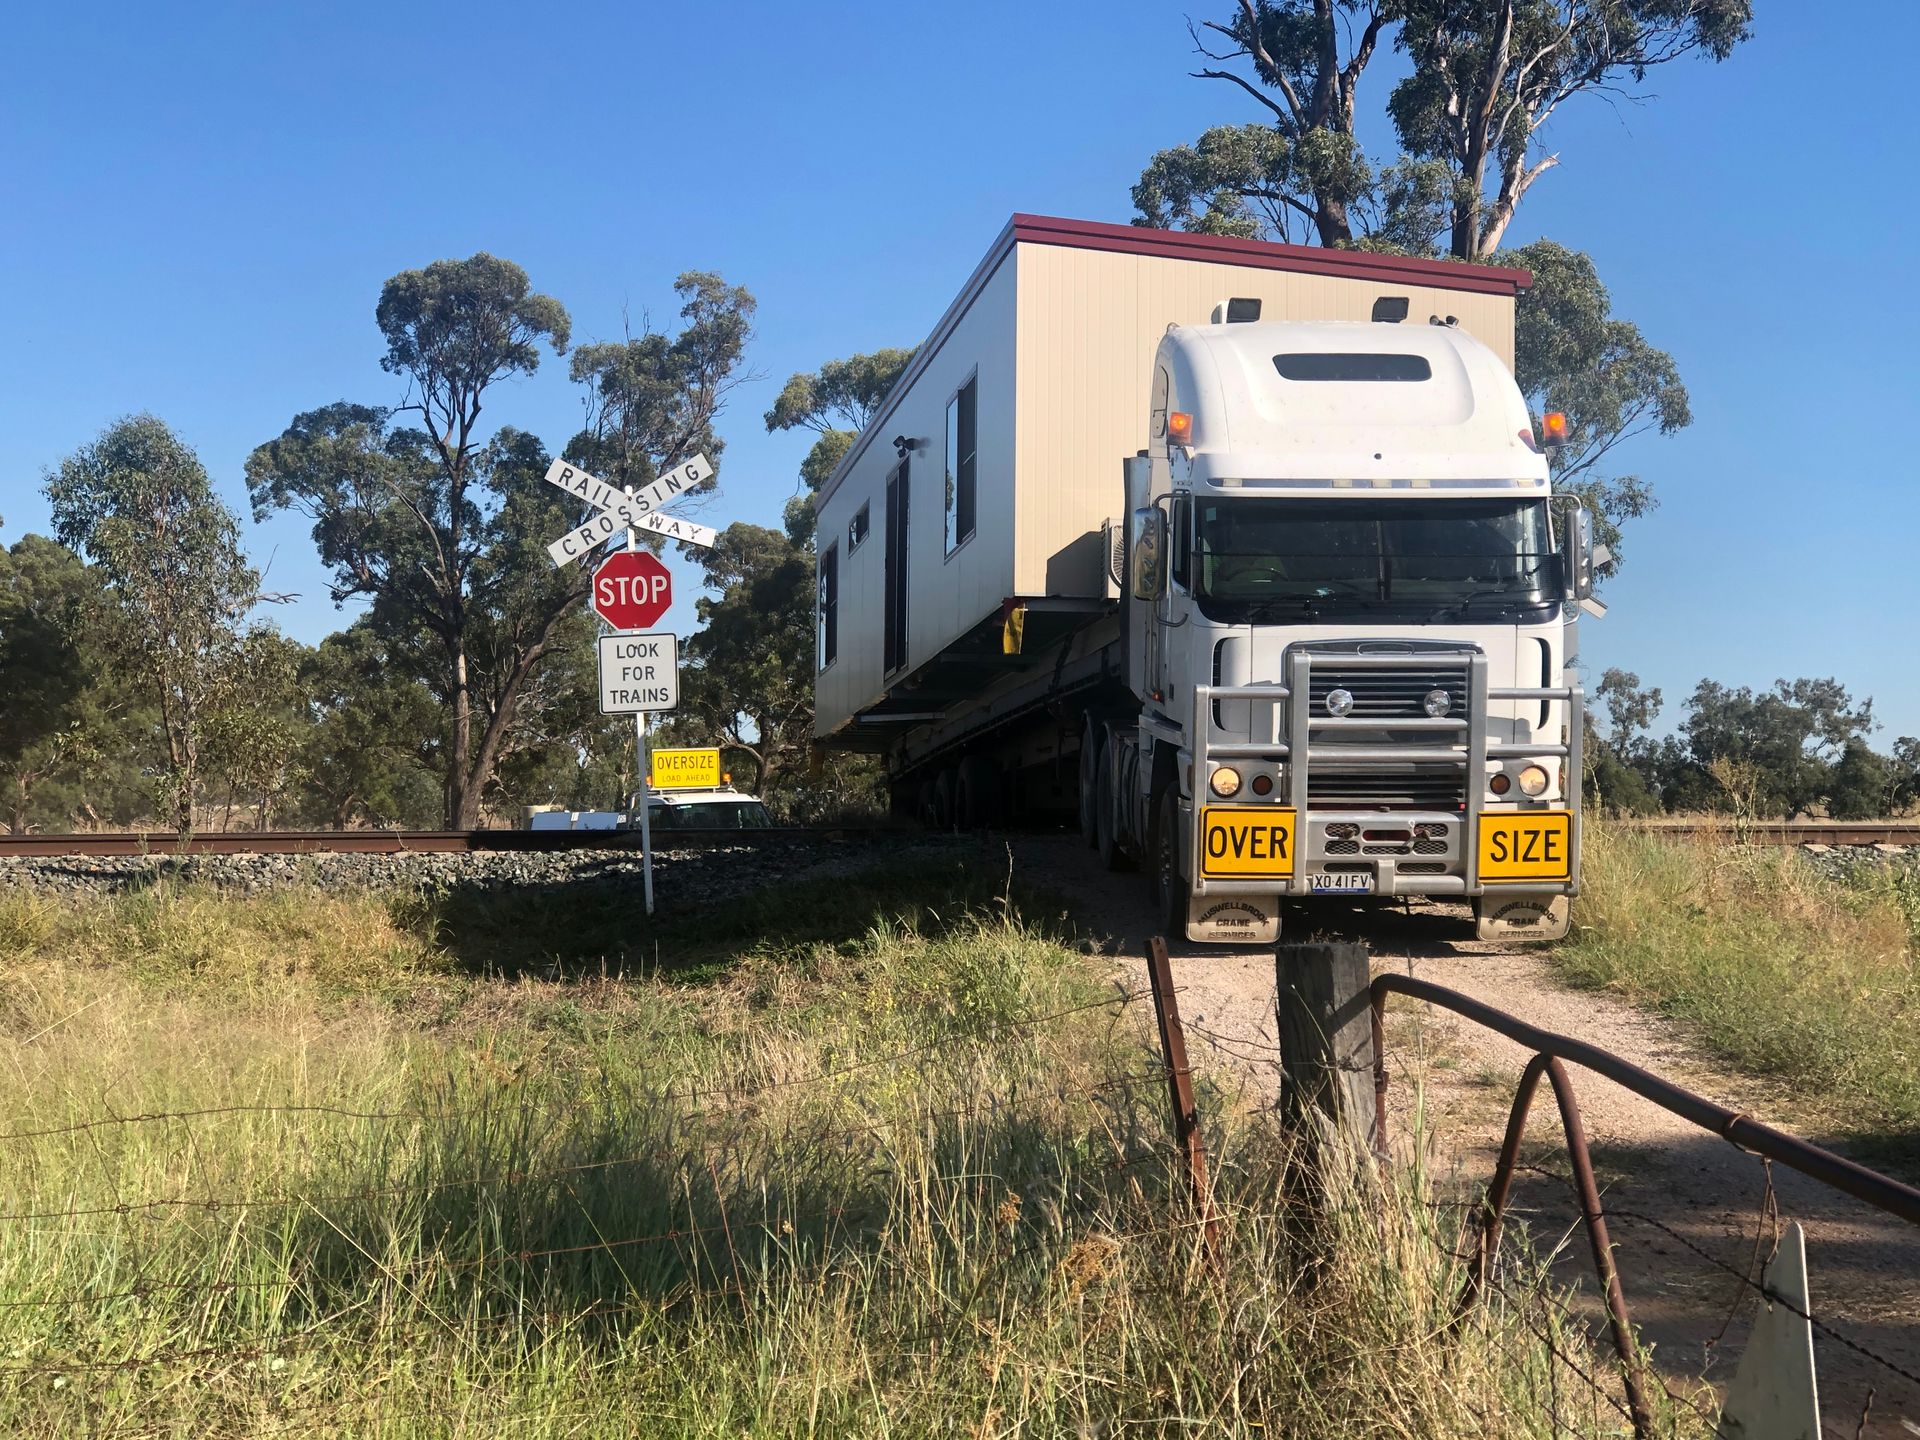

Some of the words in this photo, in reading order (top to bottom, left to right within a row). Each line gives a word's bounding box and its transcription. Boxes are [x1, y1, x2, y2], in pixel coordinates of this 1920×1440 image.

[558, 467, 611, 510] RAIL
[562, 464, 699, 555] CROSSING
[649, 513, 702, 540] WAY
[599, 575, 668, 605] STOP
[616, 643, 659, 659] LOOK
[622, 666, 655, 681] FOR
[610, 687, 669, 704] TRAINS
[657, 755, 715, 770] OVERSIZE
[686, 774, 711, 782] AHEAD
[1208, 825, 1289, 859] OVER
[1490, 829, 1561, 863] SIZE
[1216, 919, 1250, 927] CRANE
[1507, 918, 1541, 926] CRANE
